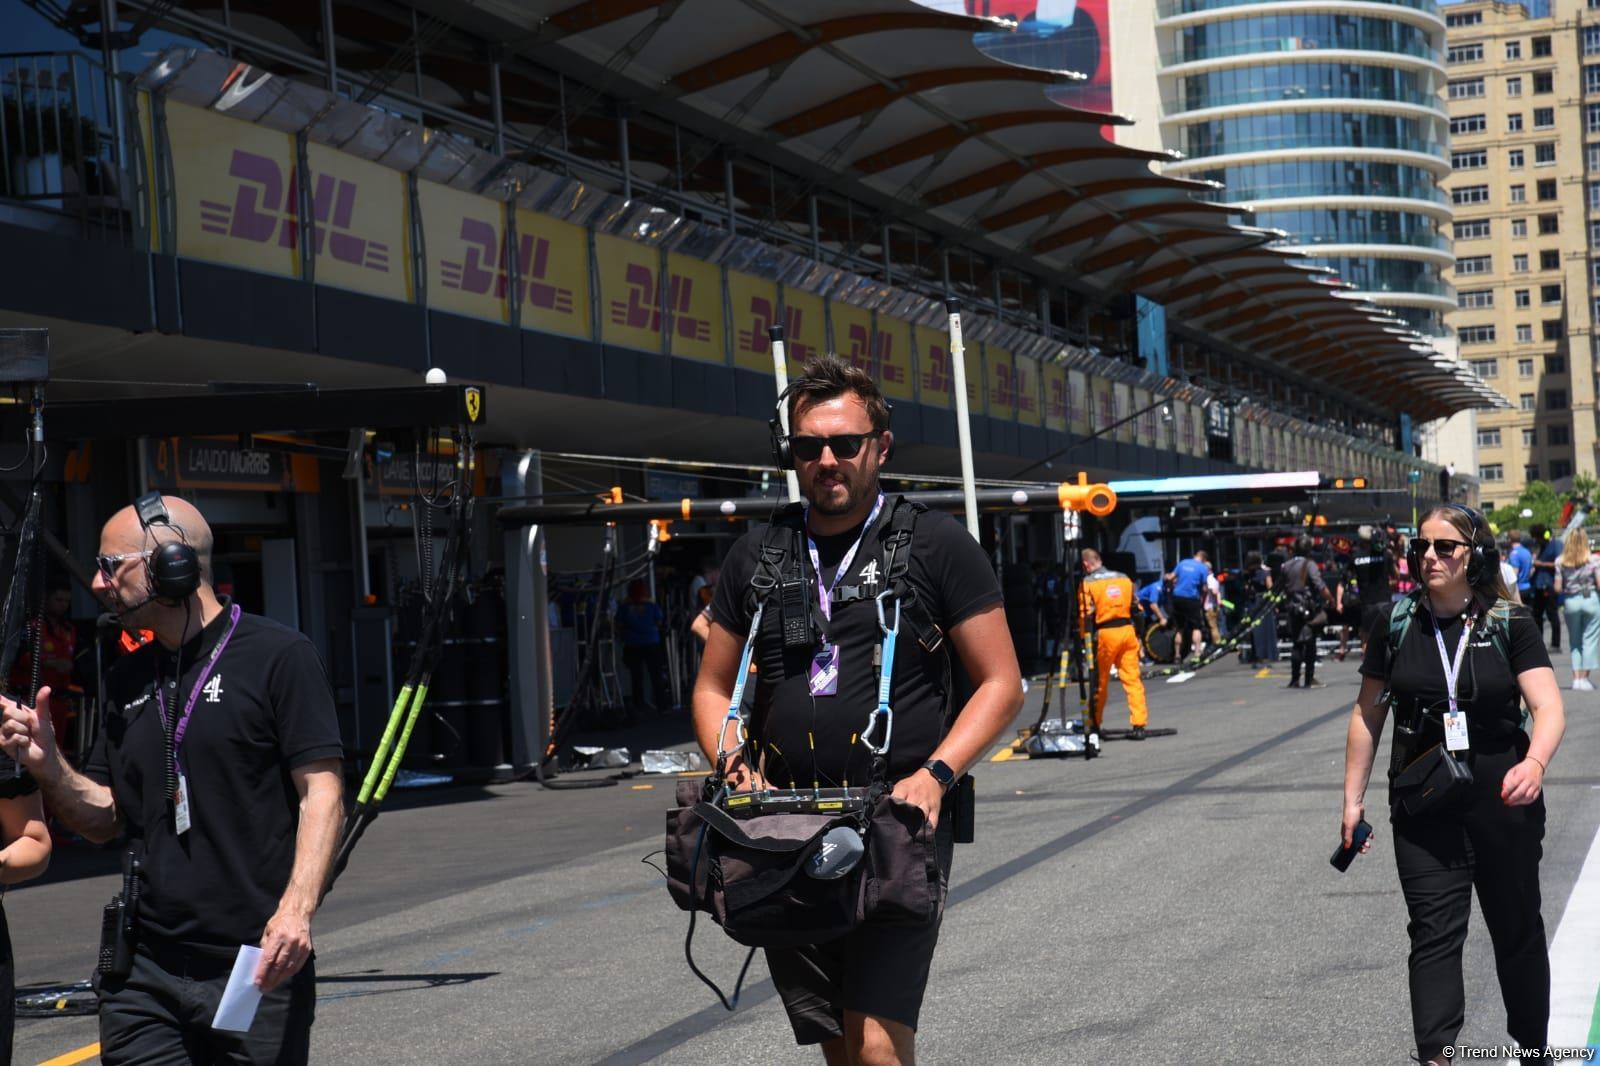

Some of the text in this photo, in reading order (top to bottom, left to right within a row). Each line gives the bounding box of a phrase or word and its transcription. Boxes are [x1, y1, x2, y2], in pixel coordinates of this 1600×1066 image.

[228, 148, 367, 266] DHL
[458, 216, 558, 310] DHL
[188, 448, 271, 475] LANDO NORRIS
